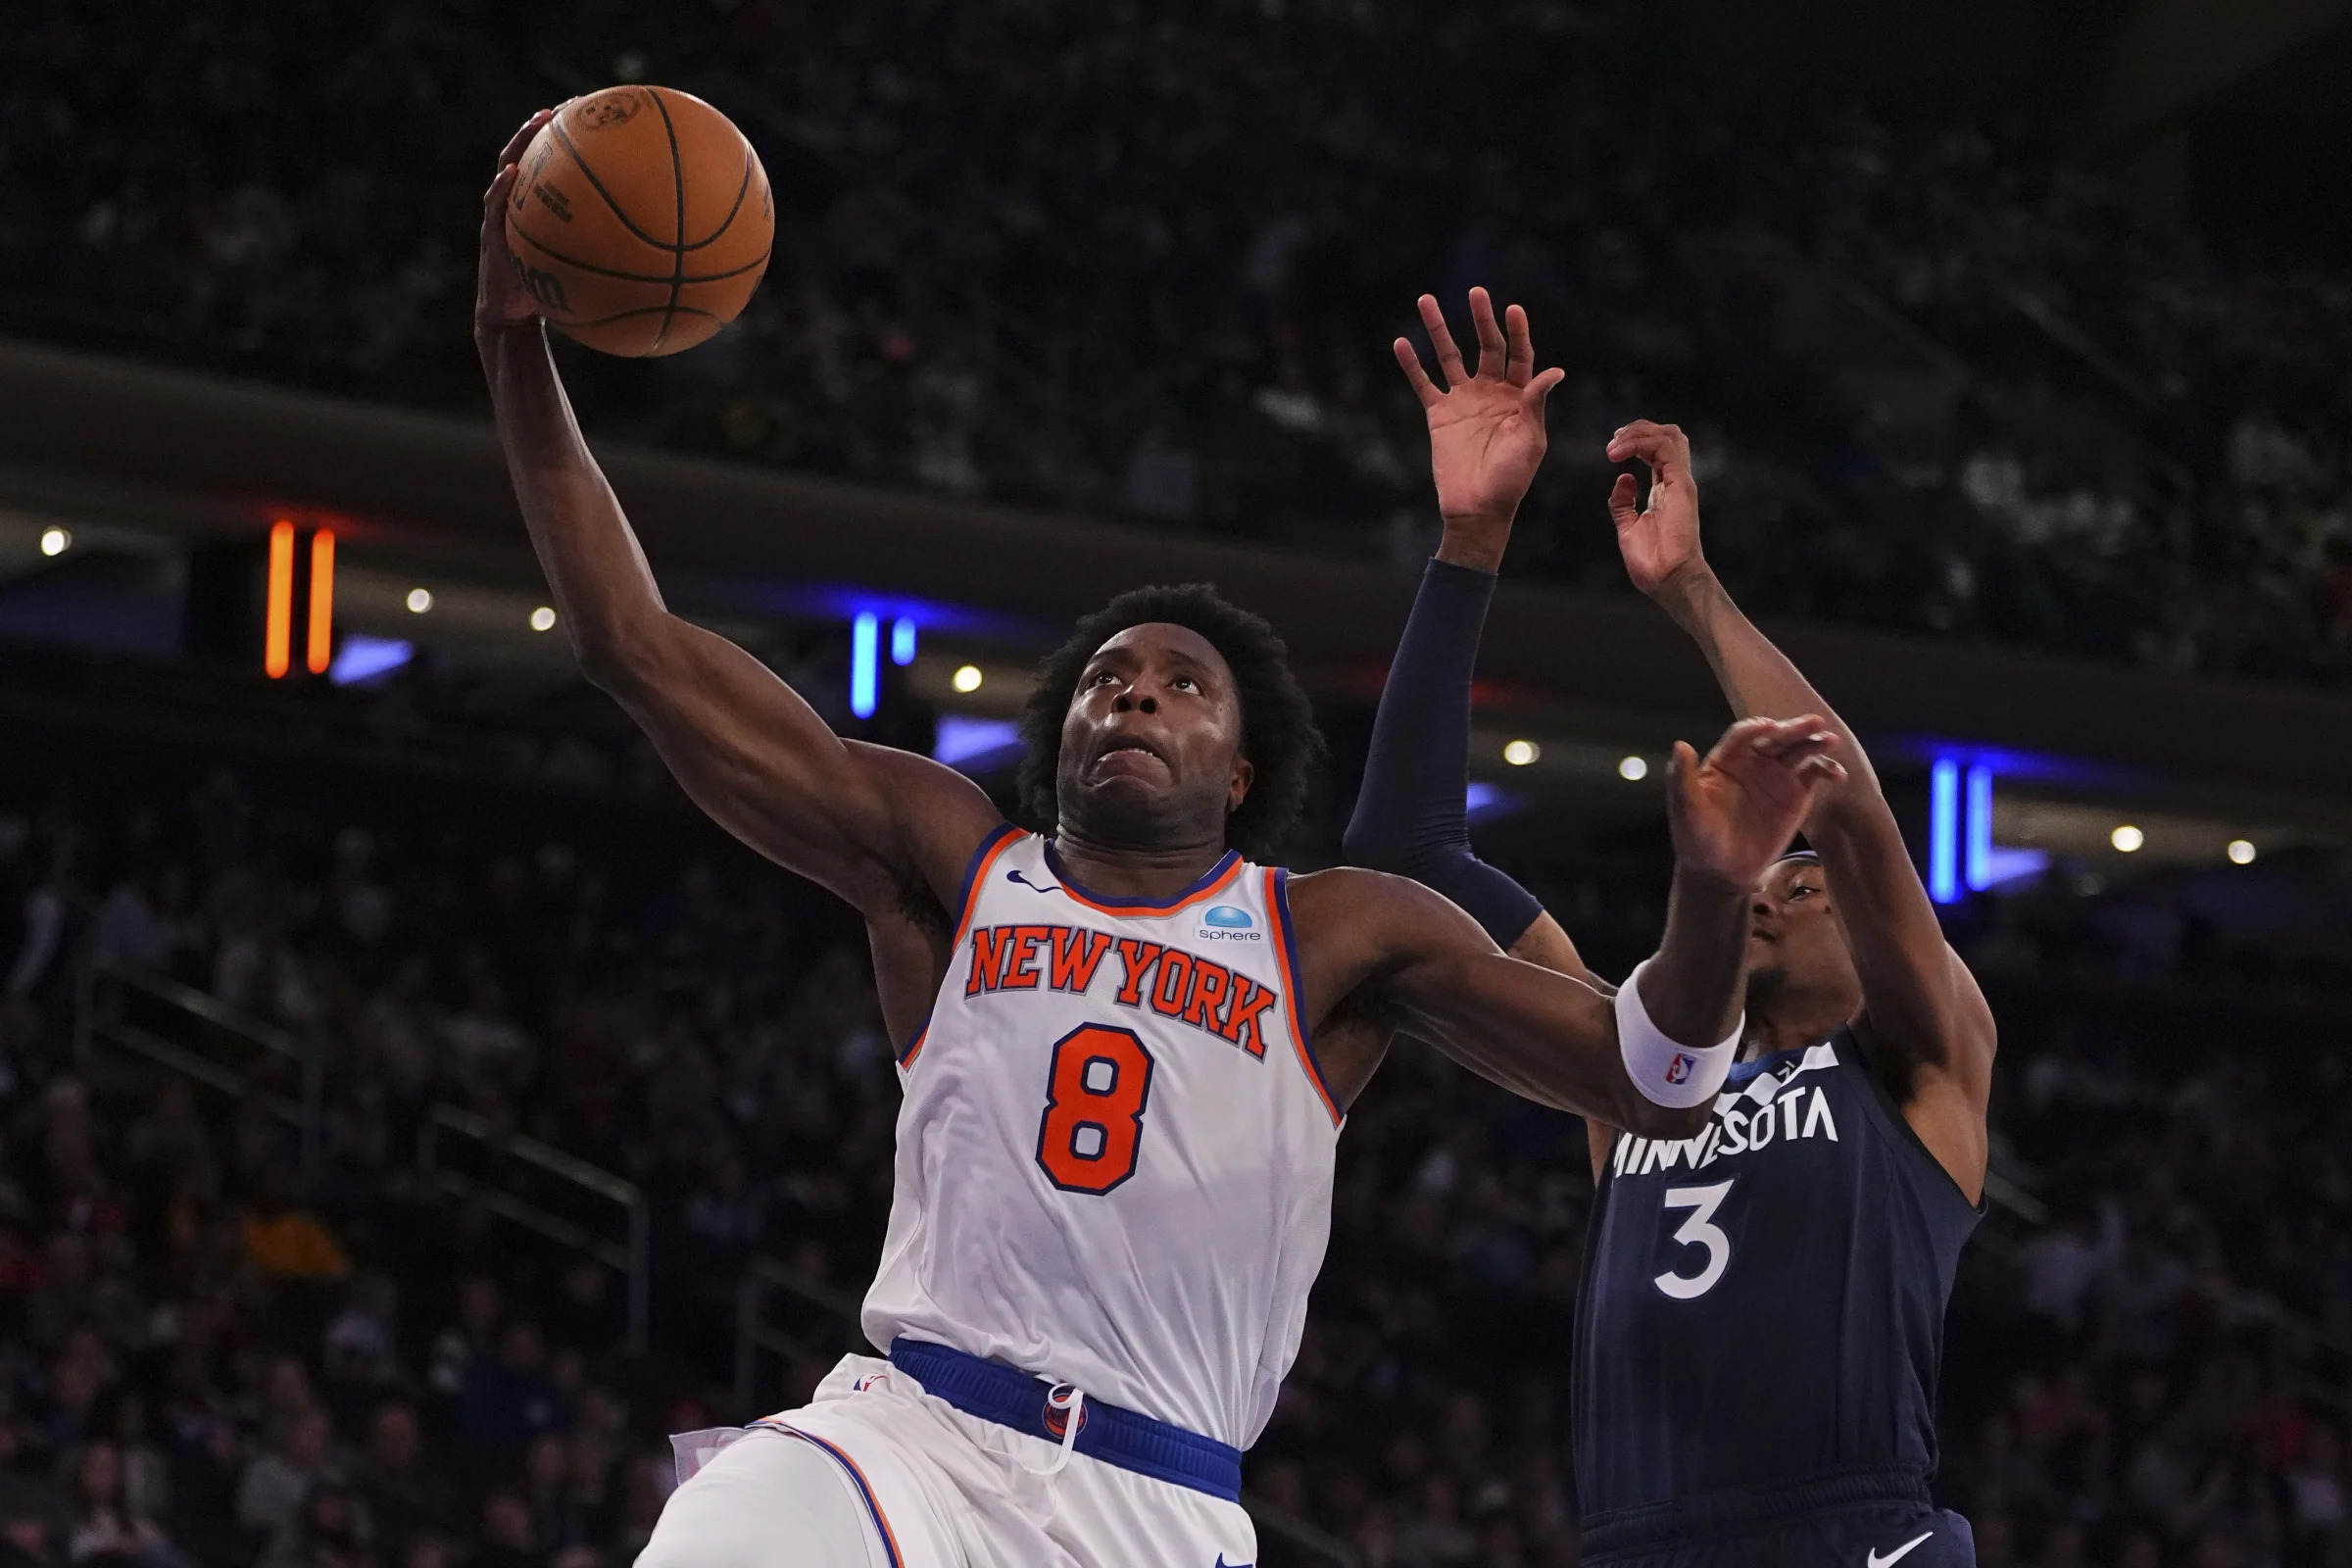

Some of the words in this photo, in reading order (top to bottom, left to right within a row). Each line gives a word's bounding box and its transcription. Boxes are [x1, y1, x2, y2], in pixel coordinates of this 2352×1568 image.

[964, 923, 1113, 1000] NEW
[1113, 938, 1279, 1064] YORK
[1198, 927, 1261, 942] sphere
[1035, 1021, 1155, 1197] 8
[1653, 1178, 1736, 1300] 3
